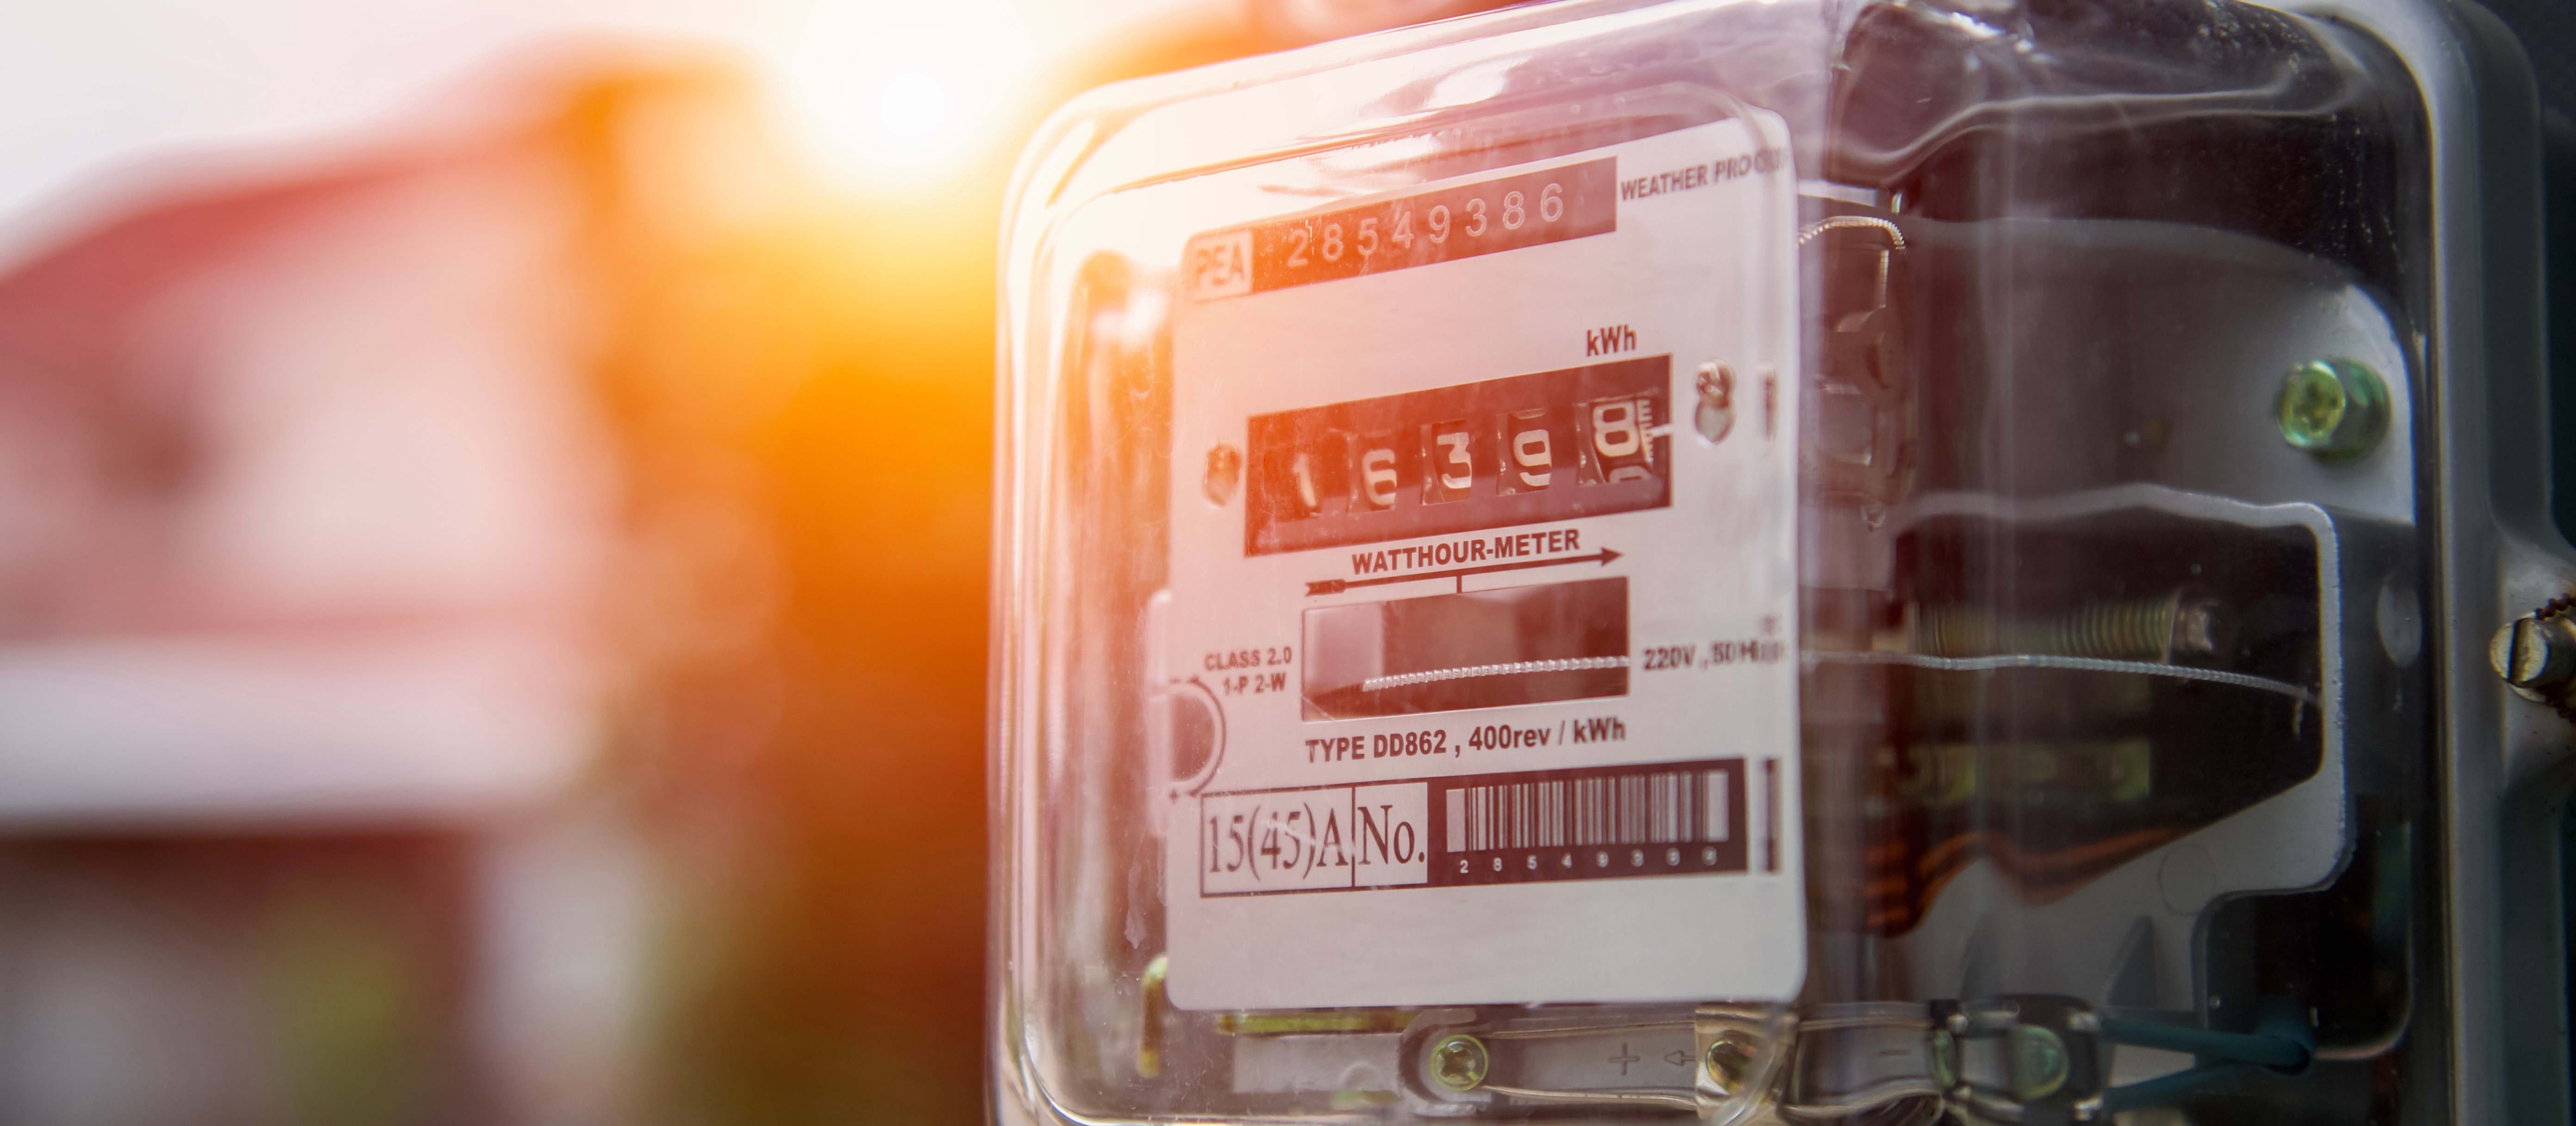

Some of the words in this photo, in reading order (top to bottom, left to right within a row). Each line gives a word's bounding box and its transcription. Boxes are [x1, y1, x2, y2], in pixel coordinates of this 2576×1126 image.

[1621, 163, 1708, 201] WEATHER
[1195, 242, 1246, 290] PEA
[1586, 323, 1637, 357] kWh
[1351, 528, 1580, 575] WATTHOUR-METER
[1204, 649, 1261, 672] CLASS
[1267, 645, 1292, 666] 2.0
[1644, 643, 1697, 671] 220V
[1223, 675, 1249, 695] 1-P
[1255, 672, 1286, 693] 2-W
[1305, 735, 1365, 764] TYPE
[1373, 729, 1447, 759] DD862
[1468, 724, 1552, 751] 400rev
[1573, 716, 1626, 744] kWh
[1209, 802, 1349, 882] 15(45)A
[1357, 804, 1425, 865] No.
